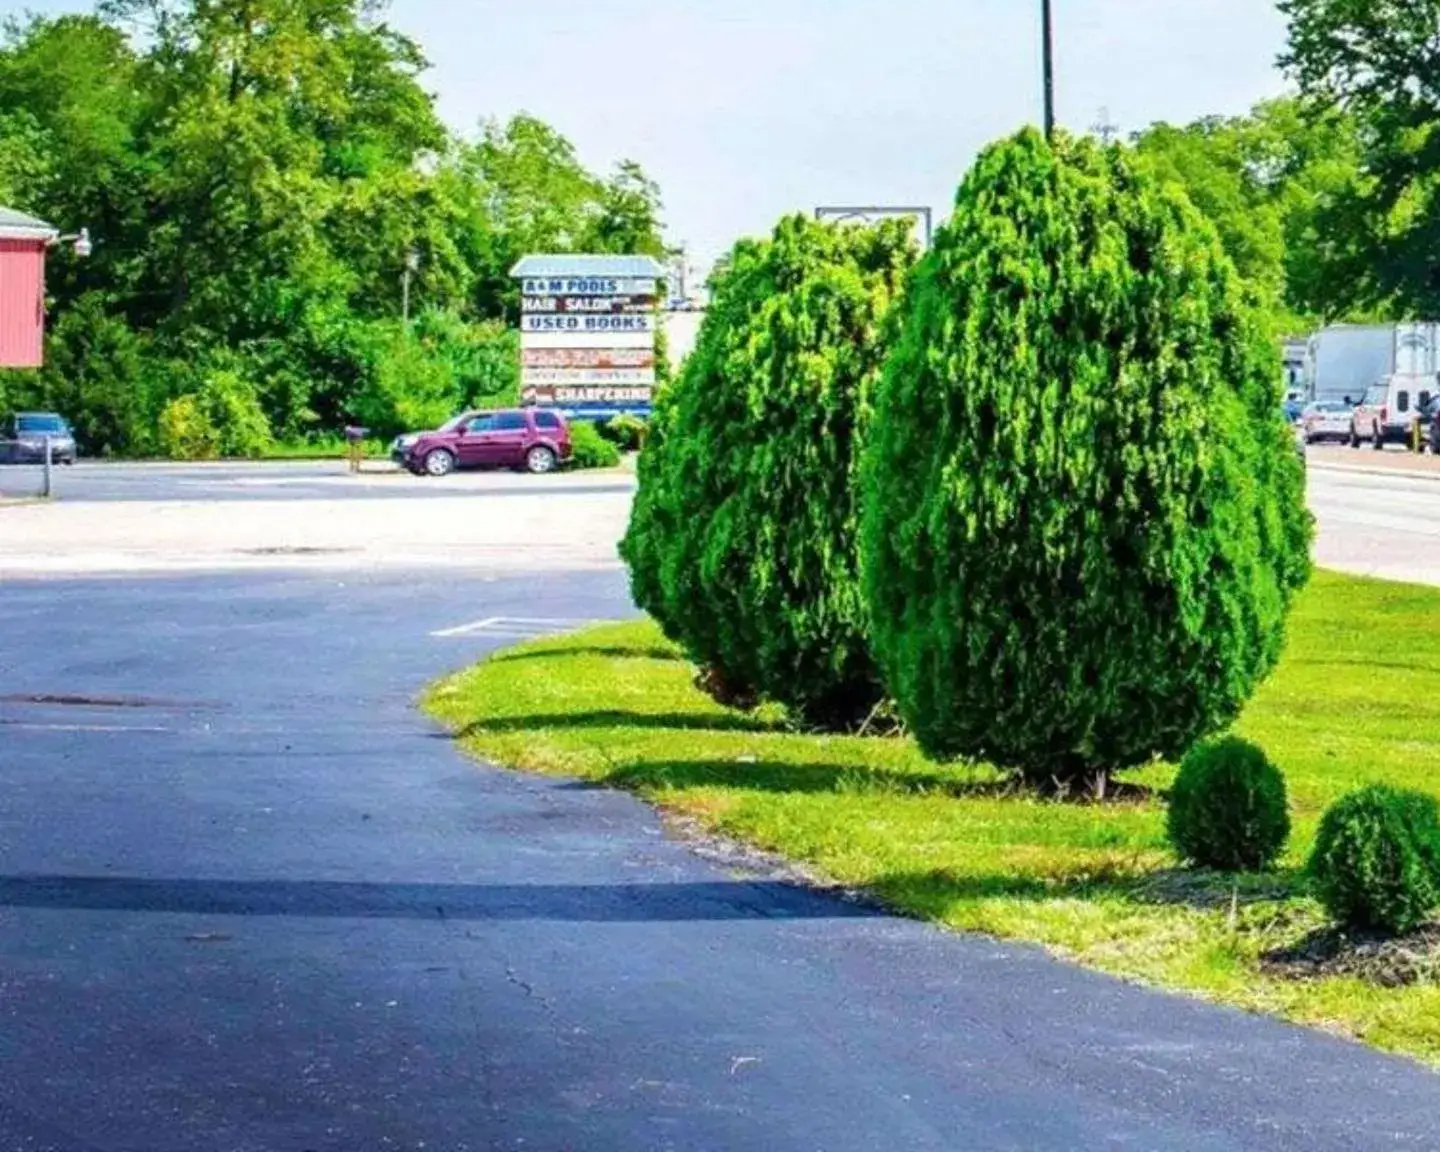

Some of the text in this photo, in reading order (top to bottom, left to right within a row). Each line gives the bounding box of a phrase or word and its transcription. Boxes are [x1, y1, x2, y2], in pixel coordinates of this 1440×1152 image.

[567, 279, 617, 292] POOLS
[529, 318, 648, 330] USED BOOKS
